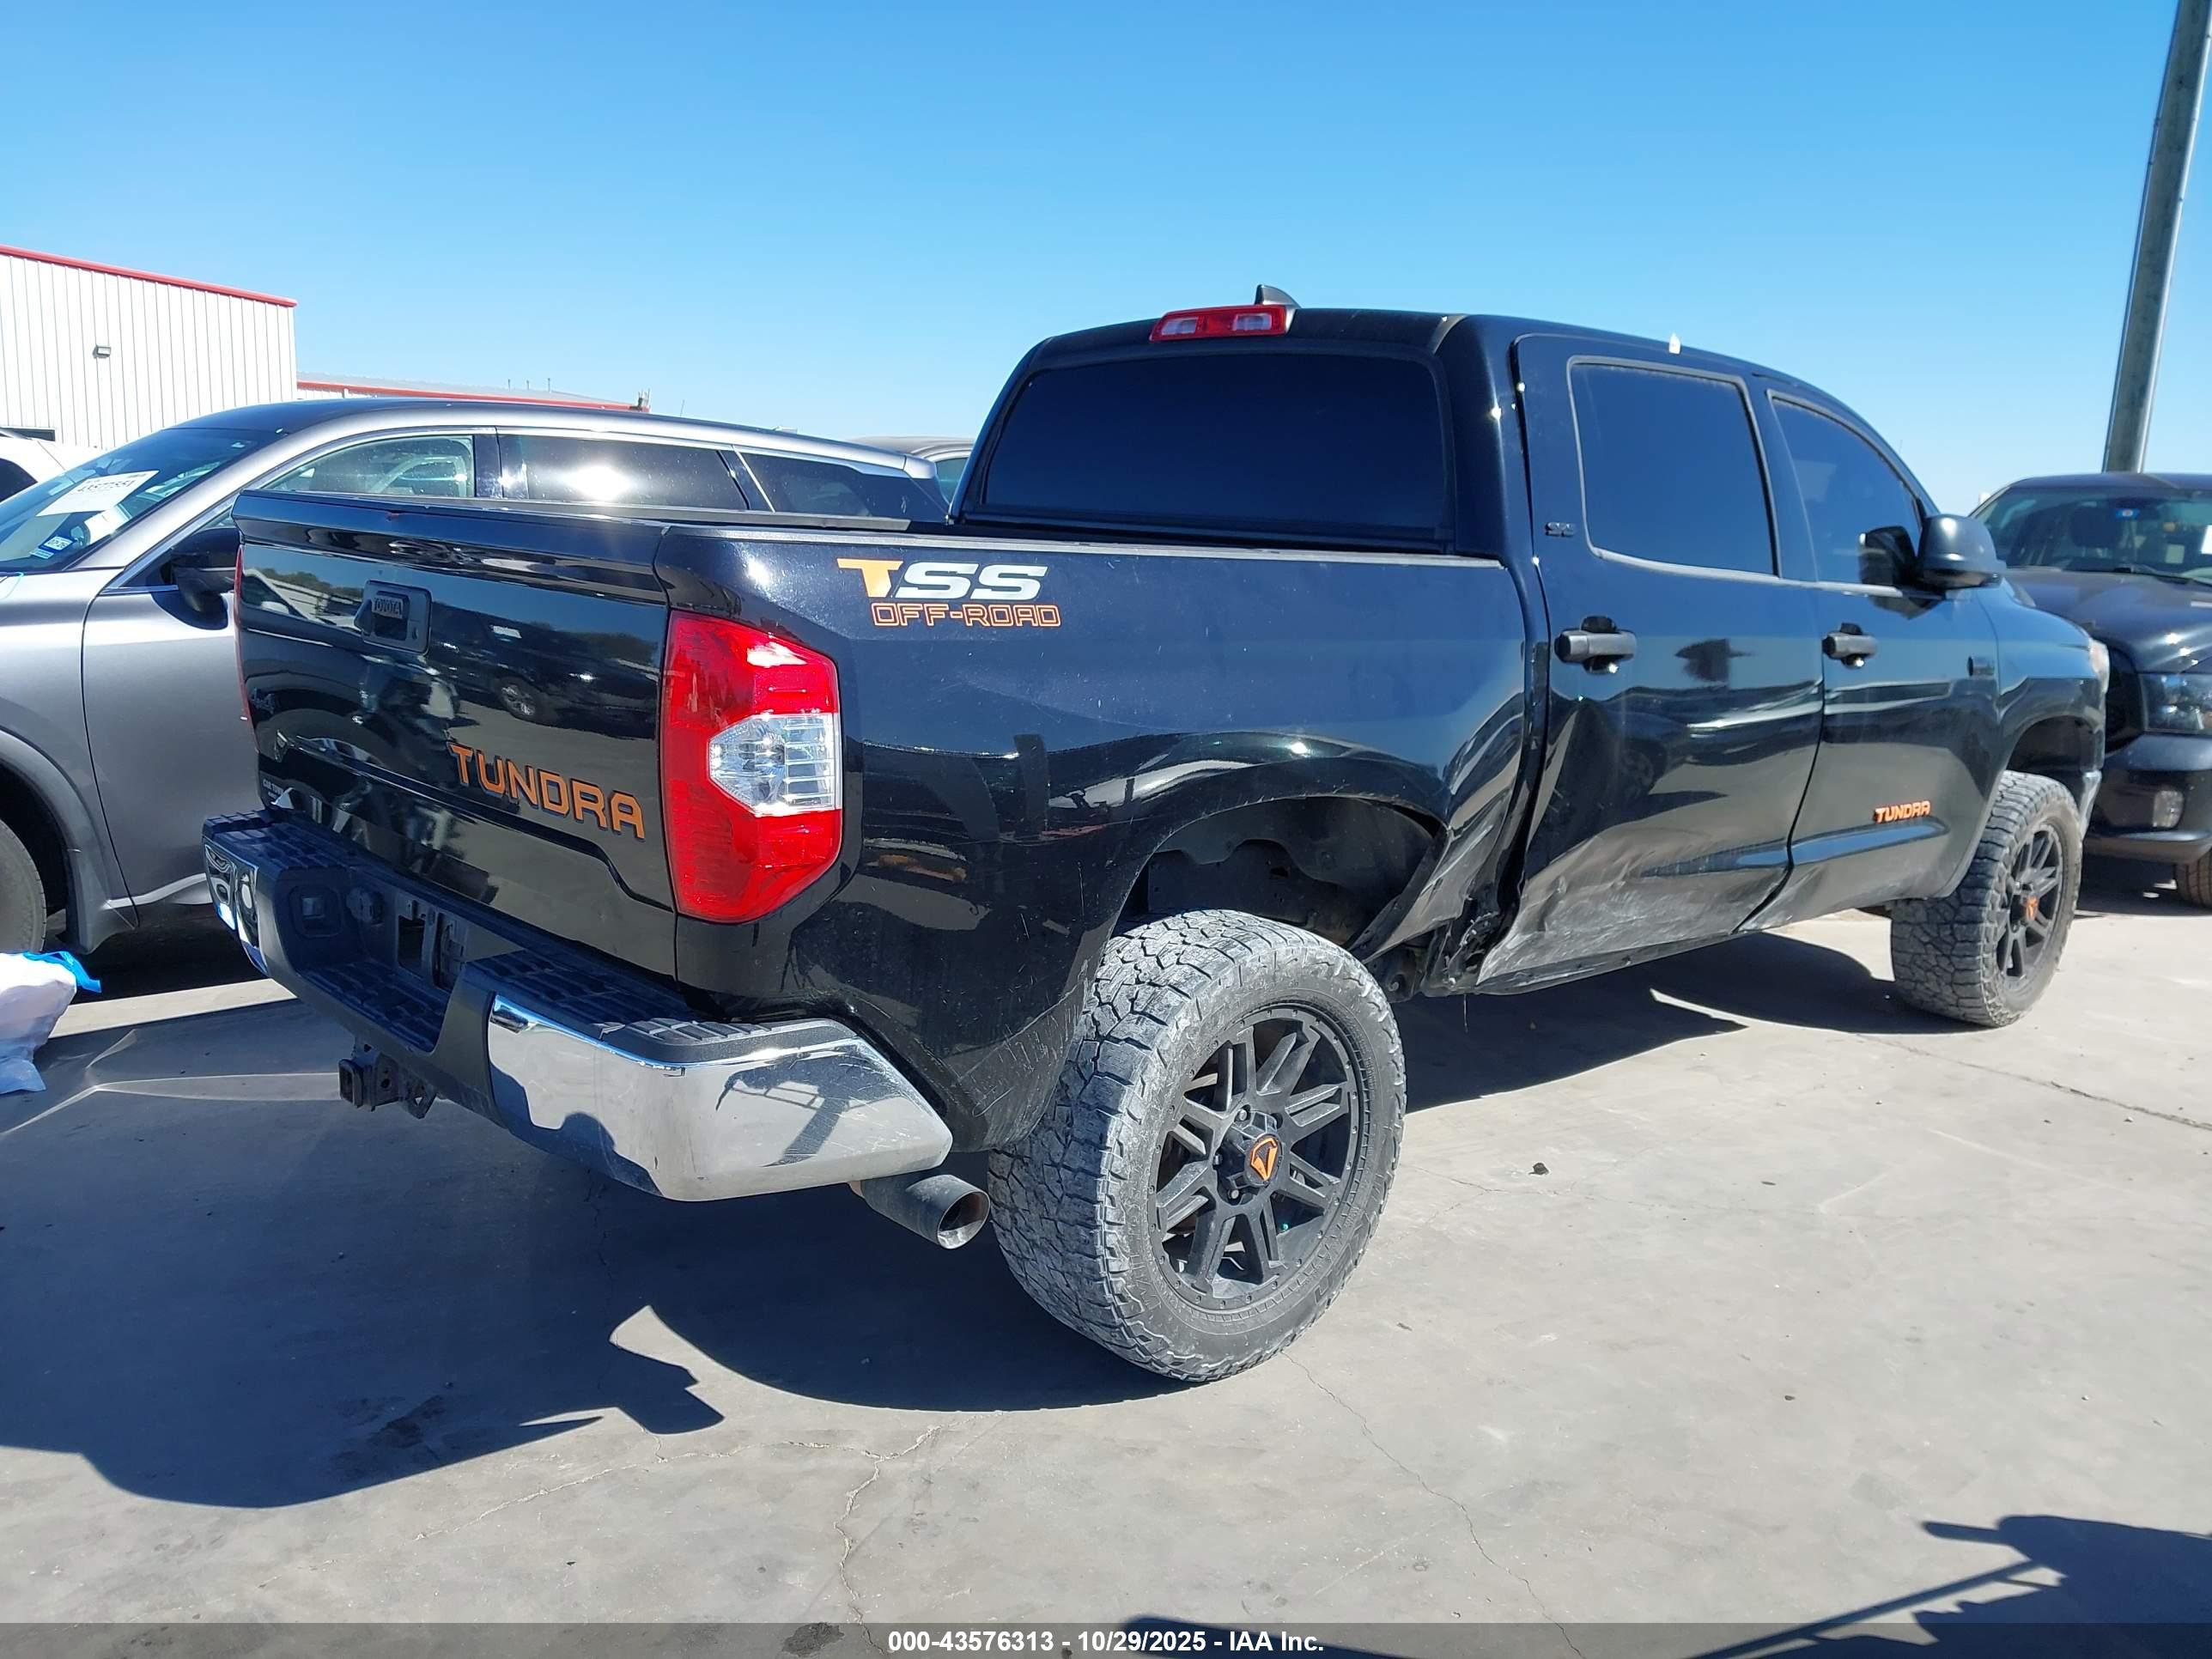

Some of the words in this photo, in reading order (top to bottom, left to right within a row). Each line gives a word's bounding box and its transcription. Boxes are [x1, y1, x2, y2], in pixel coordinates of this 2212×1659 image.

[836, 557, 1049, 601] TSS
[373, 597, 403, 616] TOYOTA
[870, 601, 1062, 628] OFF-ROAD
[447, 740, 646, 841] TUNDRA
[1874, 799, 1933, 823] TUNDRA
